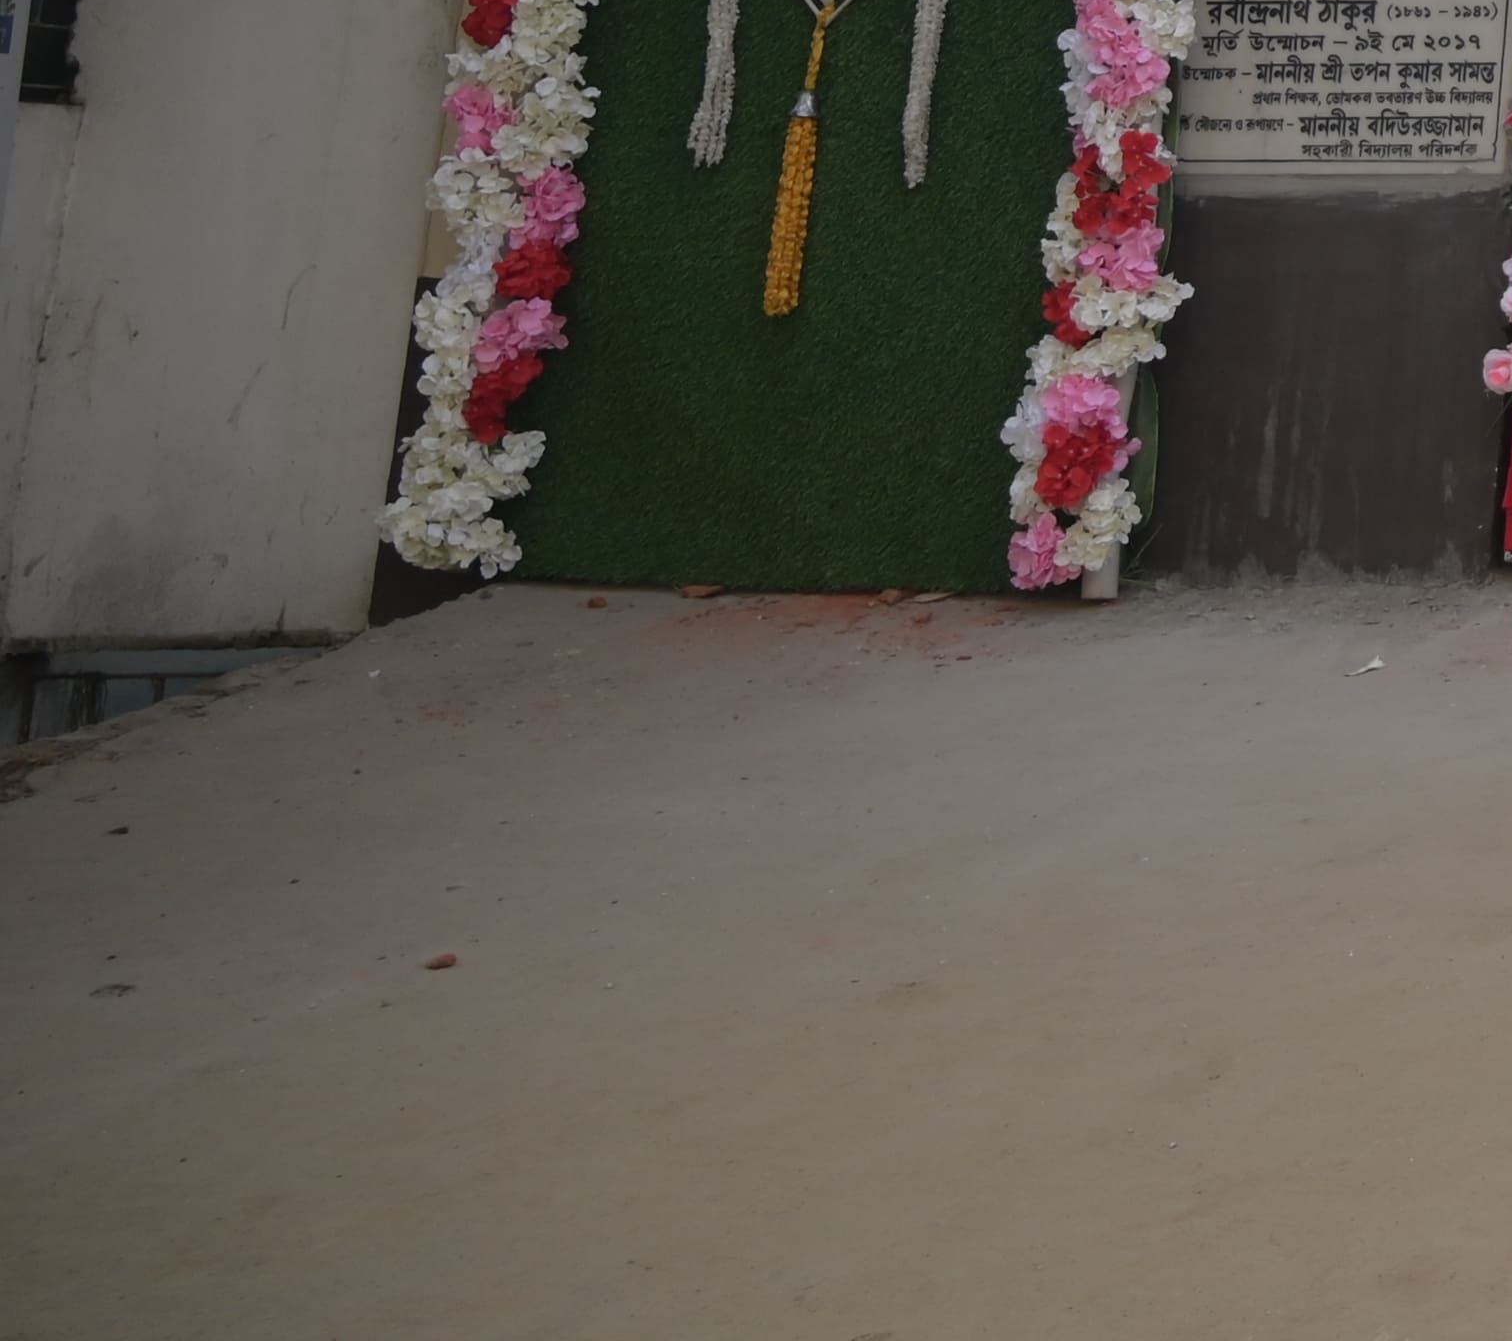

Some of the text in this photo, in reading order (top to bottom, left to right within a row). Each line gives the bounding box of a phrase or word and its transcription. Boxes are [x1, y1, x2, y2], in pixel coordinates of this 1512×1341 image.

[1202, 28, 1245, 58] মূর্তি
[1354, 28, 1384, 51] ৯ই
[1391, 35, 1415, 51] মে
[1423, 34, 1481, 52] ২০১৭
[1256, 54, 1315, 84] মাননীয়
[1320, 54, 1345, 84] শ্রী
[1349, 62, 1390, 82] তপন
[1396, 59, 1443, 88] কুমার
[1449, 59, 1497, 84] সামন্ত
[1299, 107, 1359, 137] মাননীয়
[1301, 139, 1478, 159] সহকারী বিদ্যালয় পরিদর্শক
